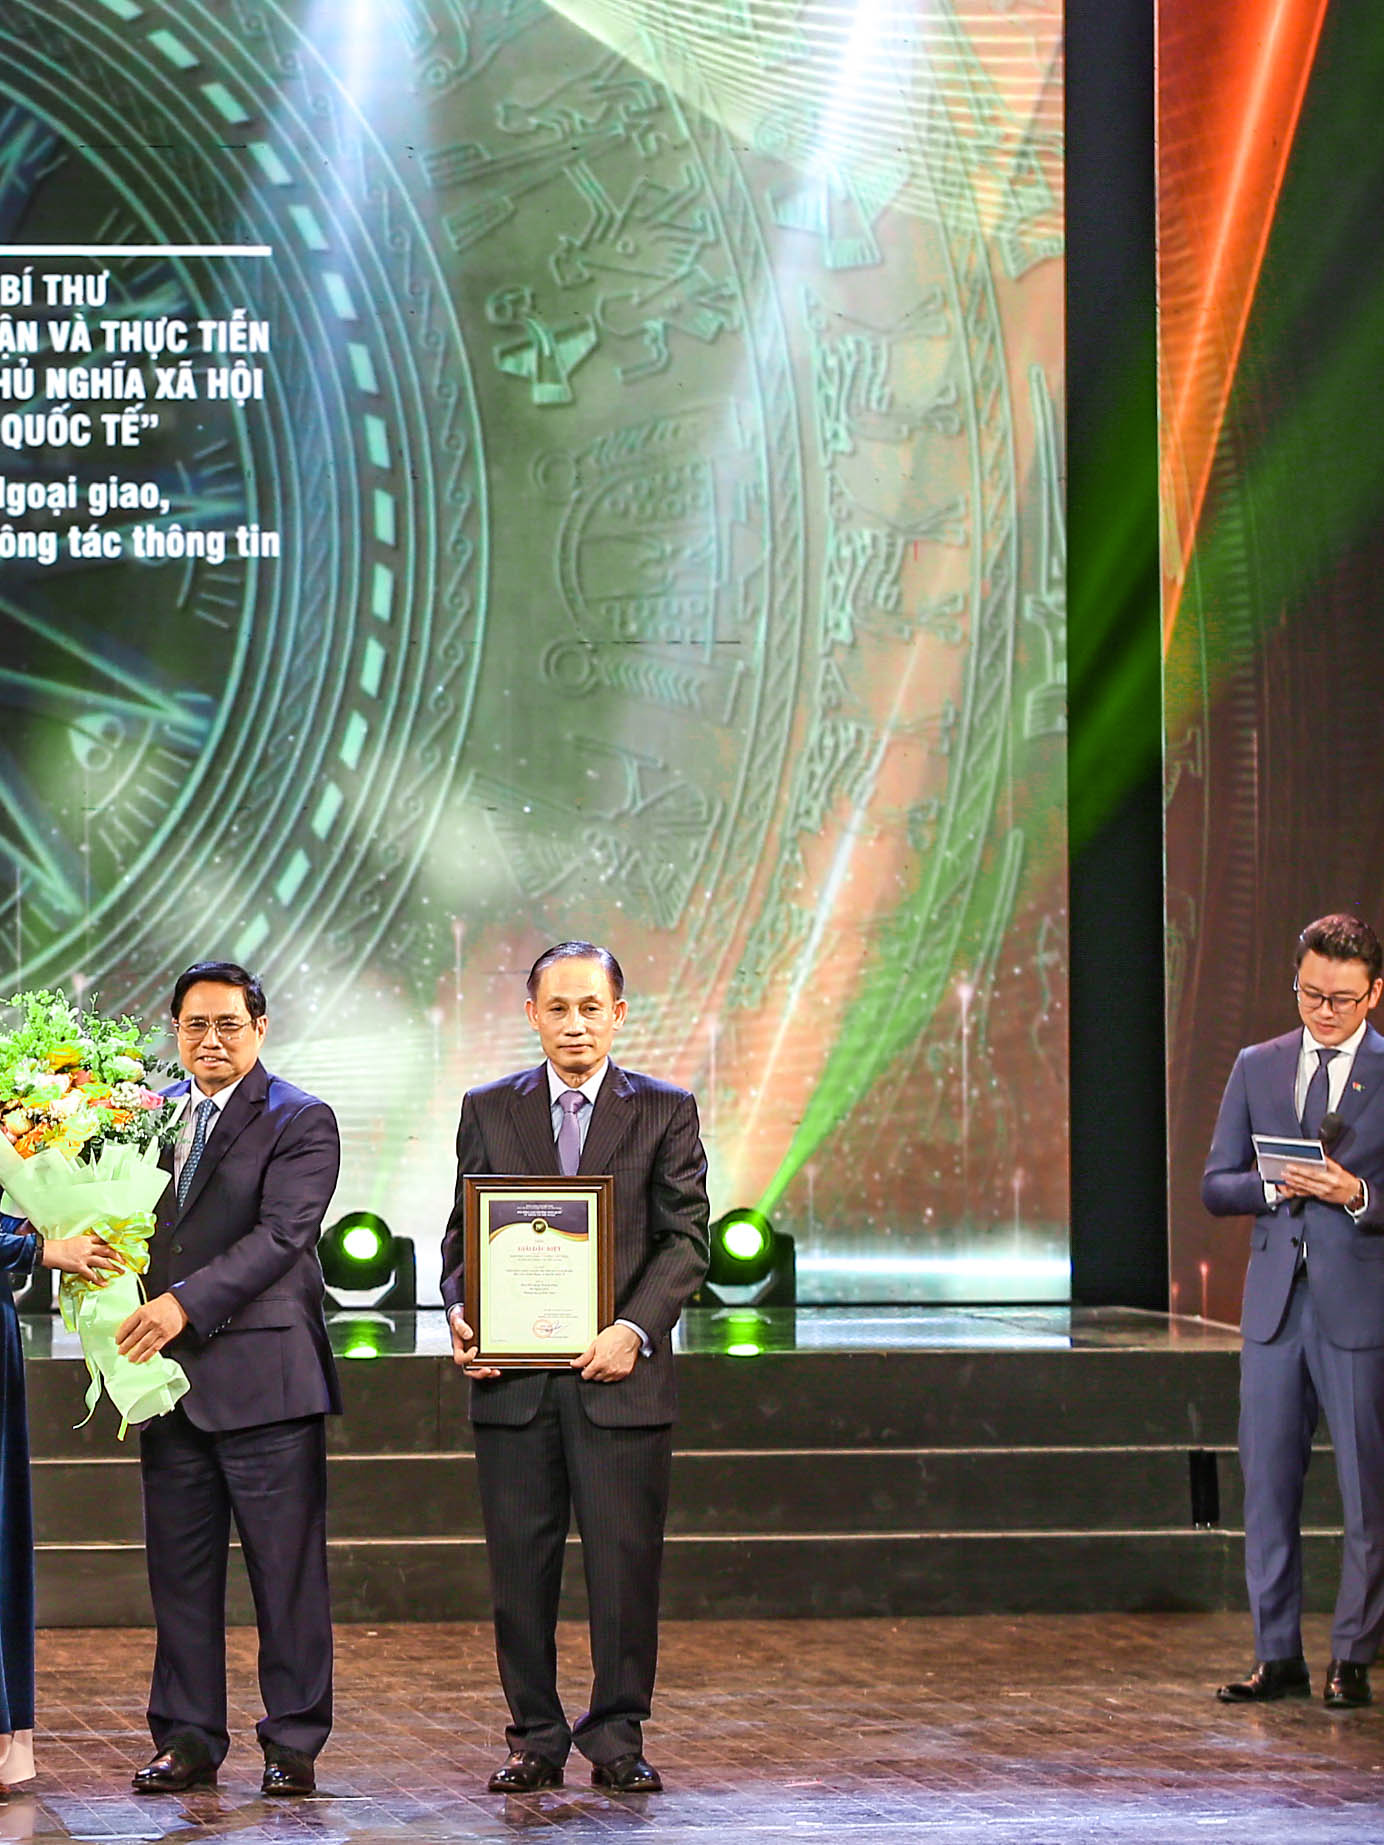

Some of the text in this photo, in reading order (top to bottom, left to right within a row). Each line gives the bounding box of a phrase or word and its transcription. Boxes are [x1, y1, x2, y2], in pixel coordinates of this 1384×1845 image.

[0, 266, 32, 305] BÍ
[42, 270, 109, 306] THƯ
[48, 313, 91, 352] VÀ
[100, 317, 187, 360] THỰC
[198, 308, 269, 353] TIỄN
[46, 361, 146, 399] NGHĨA
[155, 360, 196, 399] XÃ
[207, 359, 263, 407] HỘI
[1, 403, 91, 449] QUỐC
[101, 403, 158, 446] TẾ”
[89, 476, 169, 516] giao,
[68, 524, 121, 558] tác
[132, 524, 225, 564] thông
[235, 524, 280, 557] tin
